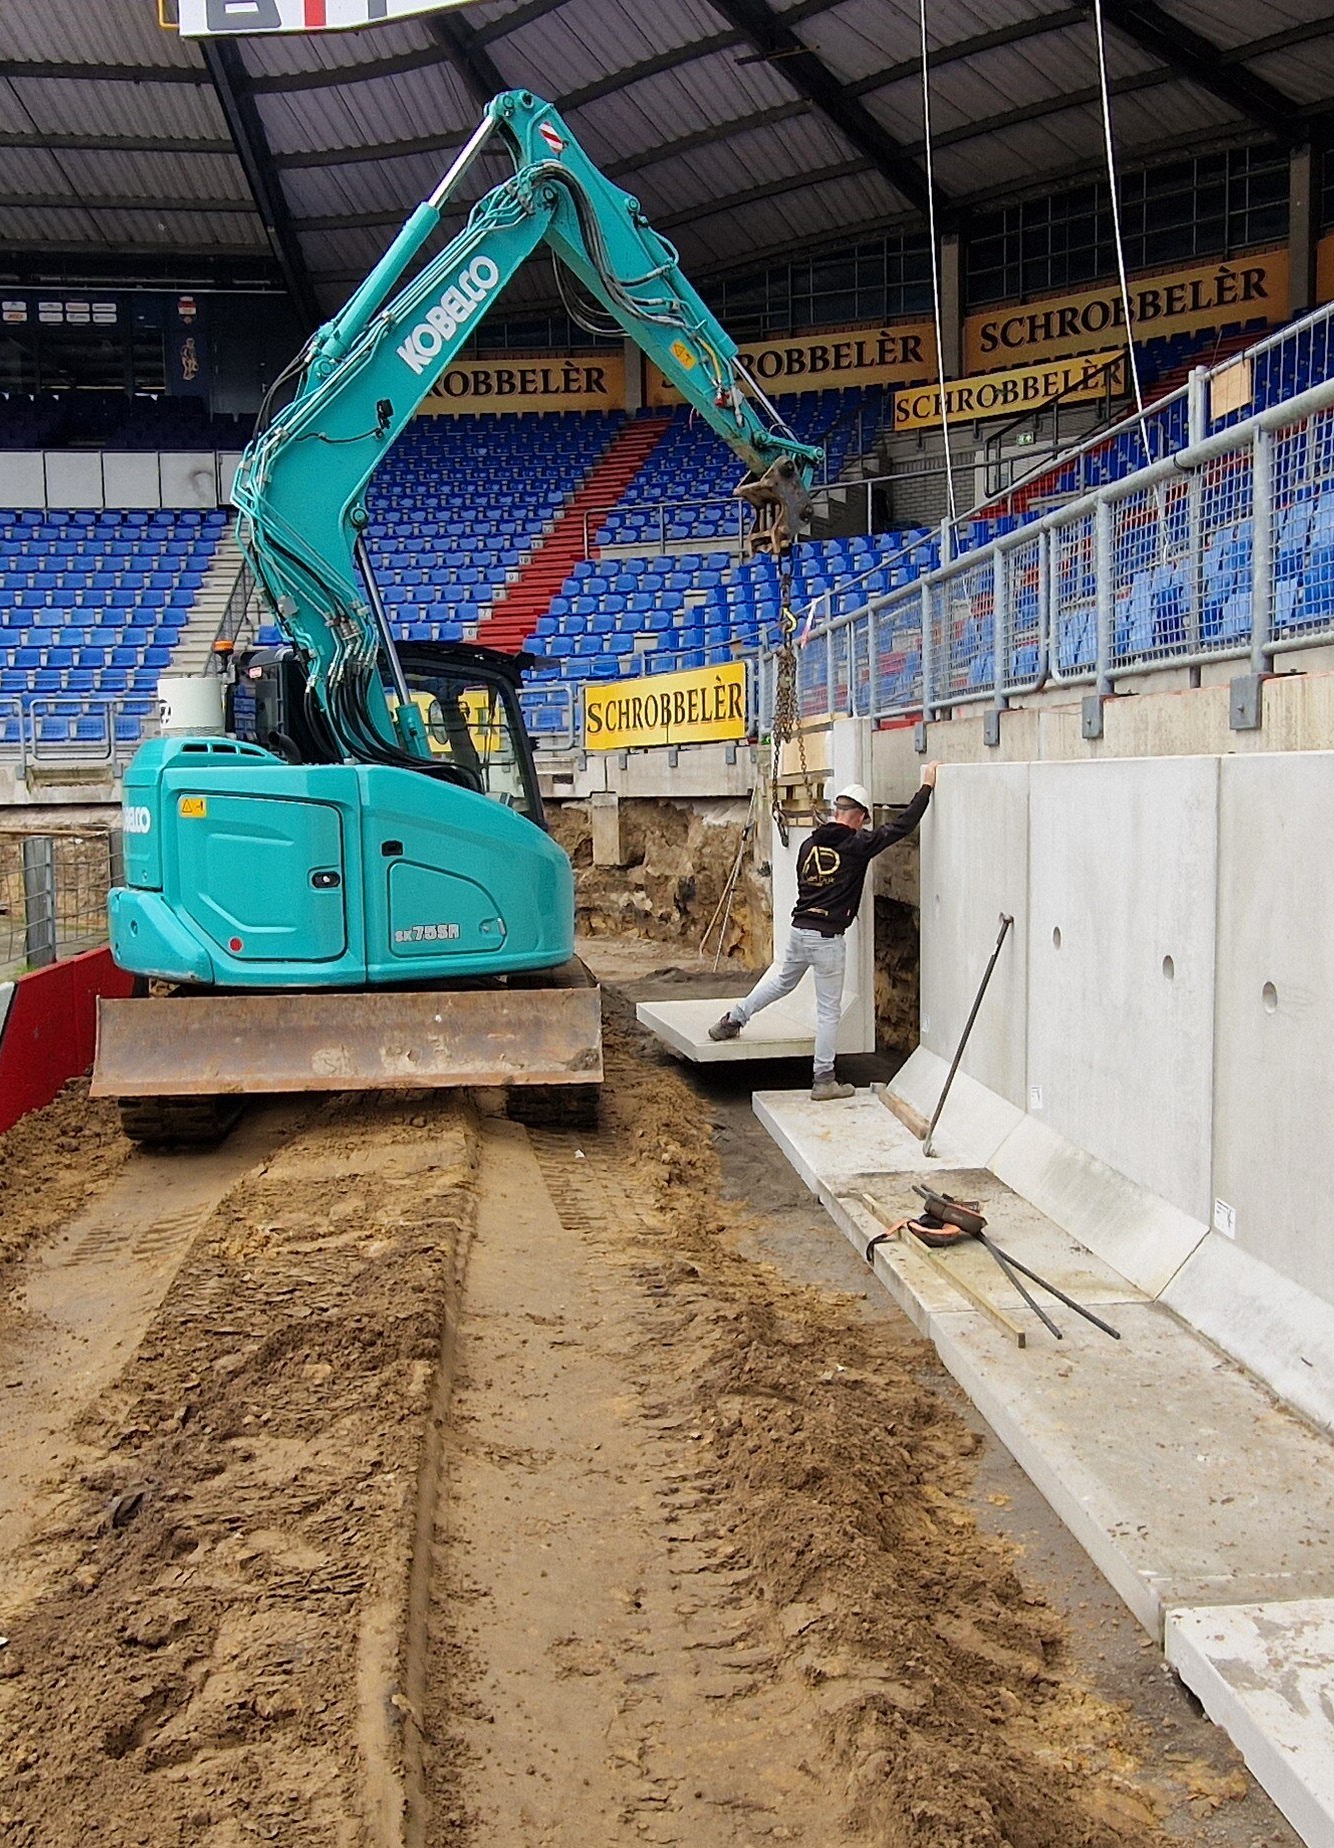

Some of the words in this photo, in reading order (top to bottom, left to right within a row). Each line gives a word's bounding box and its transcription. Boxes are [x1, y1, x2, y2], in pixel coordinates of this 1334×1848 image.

[396, 255, 499, 375] KOBELCO
[980, 266, 1268, 353] SCHROBBELÈR
[896, 359, 1122, 423] SCHROBBELÈR
[587, 675, 743, 733] SCHROBBELÈR
